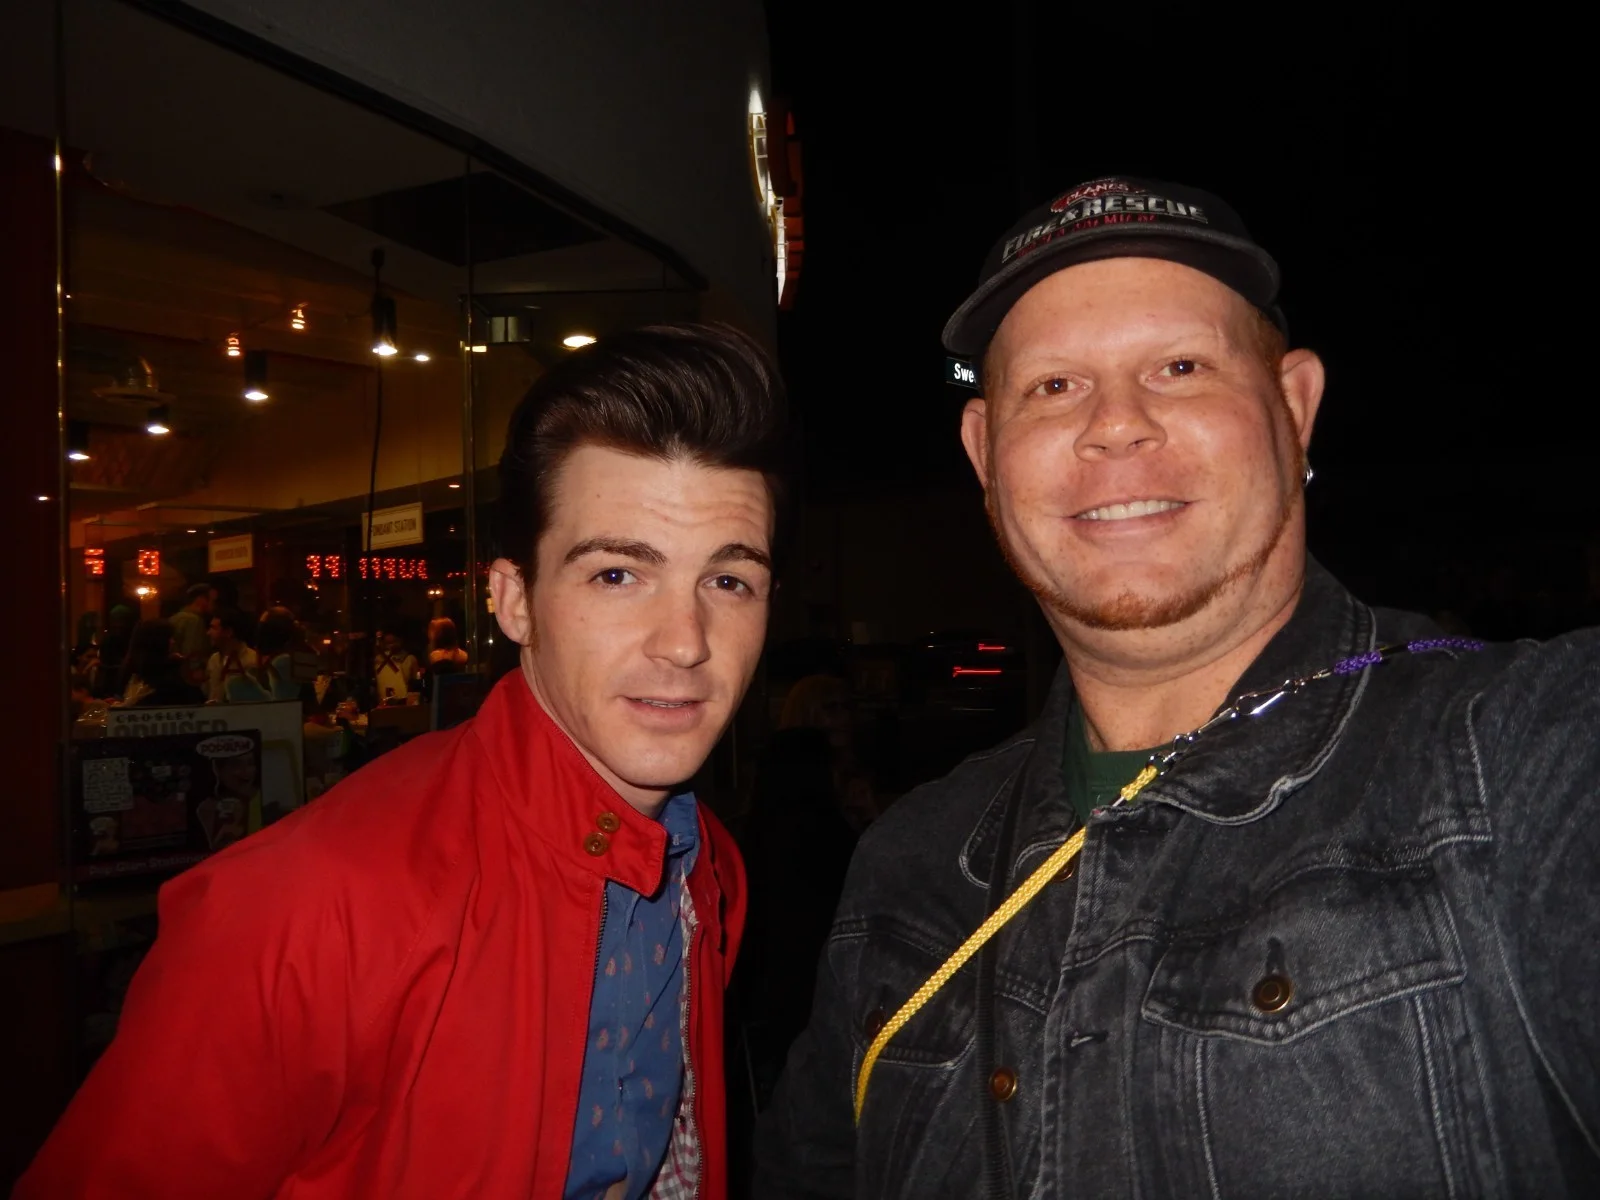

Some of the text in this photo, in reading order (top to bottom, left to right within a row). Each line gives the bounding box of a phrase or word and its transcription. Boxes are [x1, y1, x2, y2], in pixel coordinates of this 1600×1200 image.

[1082, 195, 1204, 216] RESCUE
[954, 362, 975, 383] Swe
[117, 712, 196, 723] CROSLEY
